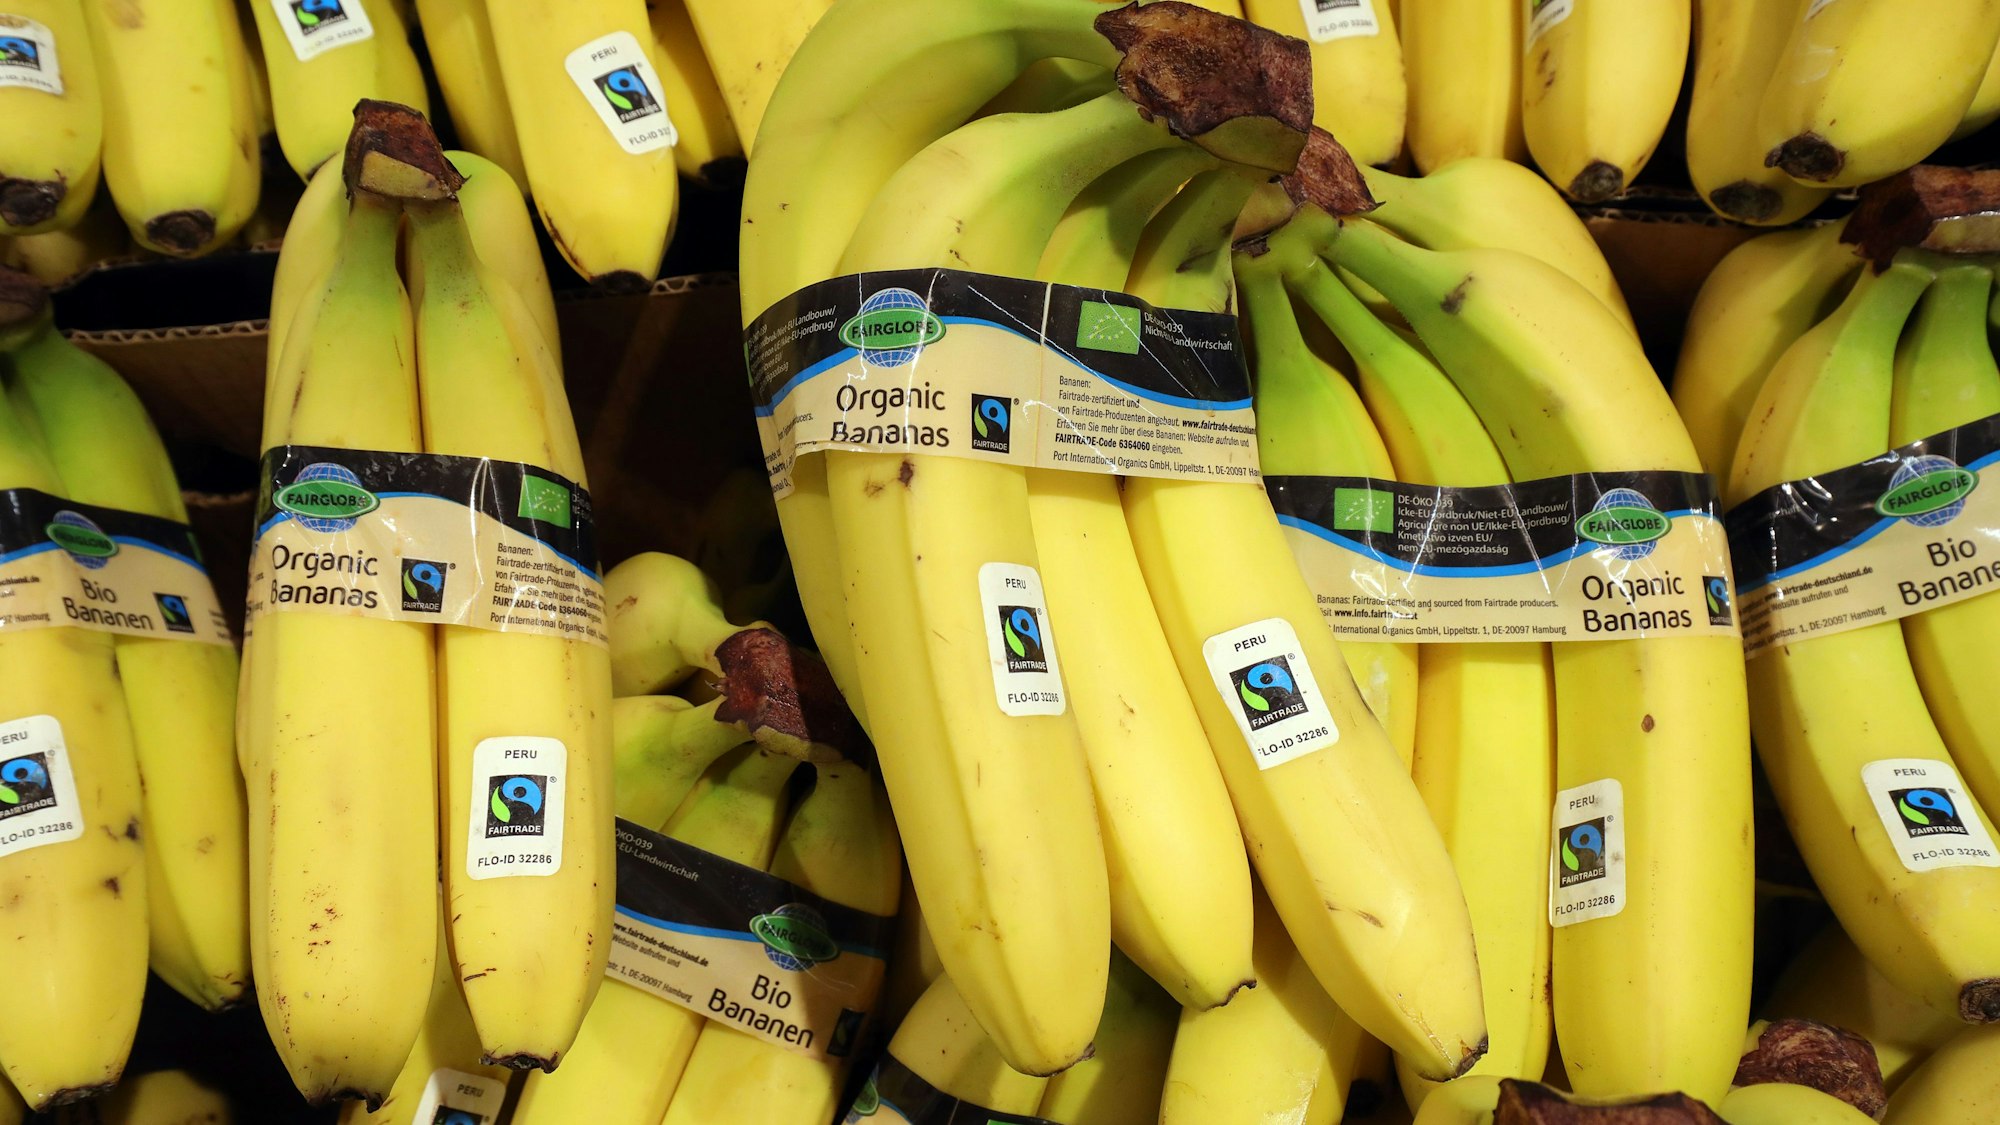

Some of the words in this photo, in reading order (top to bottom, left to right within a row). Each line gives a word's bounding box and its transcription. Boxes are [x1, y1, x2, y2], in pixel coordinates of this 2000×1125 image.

[591, 46, 618, 61] PERU
[620, 104, 659, 122] FAIRTRADE
[629, 131, 658, 145] FLO-ID
[852, 321, 934, 339] FAIRGLOBE
[1059, 375, 1092, 388] Bananen:
[836, 382, 946, 417] Organic
[1058, 390, 1125, 407] Fairtrade-zertifiziert
[1126, 399, 1140, 408] und
[1057, 406, 1070, 414] von
[1072, 406, 1145, 423] Fairtrade-Produzenten
[830, 422, 950, 447] Bananas
[1088, 421, 1099, 432] Sie
[1101, 425, 1119, 434] mehr
[1120, 425, 1135, 436] über
[1136, 428, 1155, 439] diese
[1156, 429, 1186, 441] Bananen:
[1187, 432, 1215, 444] Website
[1215, 436, 1240, 446] aufrufen
[1240, 438, 1250, 448] und
[973, 439, 1008, 450] FAIRTRADE
[1055, 433, 1117, 448] FAIRTRADE-Code
[1118, 439, 1150, 451] 6364060
[1152, 444, 1184, 455] eingeben.
[1053, 451, 1068, 461] Port
[1070, 453, 1116, 466] International
[1118, 457, 1148, 470] Organics
[1149, 460, 1172, 472] GmbH,
[1207, 465, 1215, 475] 1,
[1216, 466, 1247, 476] DE-20097
[286, 493, 367, 508] FAIRGLOBE
[1398, 494, 1454, 508] DE-ÖKO-039
[1888, 474, 1969, 511] FAIRGLOBE
[1398, 507, 1514, 520] Icke-EU-ordbruk/Niet-EU
[1516, 501, 1569, 517] andbouw/
[1398, 519, 1448, 531] Agriculure
[1588, 518, 1662, 533] FAIRGLOBE
[1448, 534, 1474, 542] izven
[1475, 533, 1494, 543] EU/
[497, 542, 534, 556] Bananen:
[1398, 544, 1419, 552] nem
[1926, 537, 1977, 567] Bio
[272, 545, 378, 579] Organic
[495, 570, 508, 580] von
[1005, 577, 1027, 590] PERU
[1897, 560, 2000, 606] Banane
[80, 578, 117, 604] Bio
[270, 579, 378, 609] Bananas
[527, 587, 540, 597] Sie
[1582, 570, 1685, 605] Organic
[1801, 590, 1833, 603] aufrufen
[1834, 584, 1849, 596] und
[403, 601, 440, 611] FAIRTRADE
[1317, 594, 1351, 604] Bananas:
[1352, 595, 1385, 606] Fairtrade
[1417, 599, 1432, 608] and
[1434, 598, 1463, 608] sourced
[1465, 598, 1482, 607] from
[1484, 598, 1518, 607] Fairtrade
[1520, 599, 1559, 608] producers.
[62, 596, 155, 630] Bananen
[1583, 609, 1692, 633] Bananas
[1799, 624, 1809, 634] 1,
[1809, 614, 1848, 631] DE-20097
[1850, 605, 1887, 621] Hamburg
[490, 612, 506, 624] Port
[507, 615, 556, 629] International
[558, 621, 585, 634] Organics
[1333, 624, 1380, 635] International
[1382, 625, 1414, 636] Organics
[1415, 627, 1441, 636] GmbH,
[1482, 626, 1490, 636] 1,
[1492, 625, 1530, 635] DE-20097
[1532, 625, 1567, 635] Hamburg
[1234, 634, 1267, 652] PERU
[1010, 660, 1047, 670] FAIRTRADE
[1008, 692, 1040, 704] FLO-ID
[1041, 692, 1059, 703] 32286
[1251, 702, 1305, 728] FAIRTRADE
[0, 731, 28, 745] ERU
[1258, 737, 1294, 756] LO-ID
[1295, 726, 1329, 744] 32286
[504, 749, 538, 759] PERU
[1893, 768, 1927, 777] PERU
[0, 797, 55, 819] FAIRTRADE
[1569, 795, 1595, 810] PERU
[39, 821, 74, 835] 32286
[488, 825, 541, 835] FAIRTRADE
[1910, 825, 1966, 836] FAIRTRADE
[477, 854, 515, 868] FLO-ID
[518, 854, 552, 864] 32286
[1912, 848, 1955, 862] FLO-ID
[1957, 847, 1991, 857] 32286
[1561, 867, 1604, 885] FAIRTRADE
[1555, 901, 1586, 916] FLO-ID
[1587, 894, 1616, 908] 32286
[612, 933, 639, 951] Website
[639, 946, 667, 962] aufrufen
[667, 958, 681, 968] und
[628, 969, 663, 989] DE-20097
[662, 983, 693, 1003] Hamburg
[750, 974, 792, 1009] Bio
[707, 988, 815, 1049] Bananen
[456, 1083, 485, 1098] PERU
